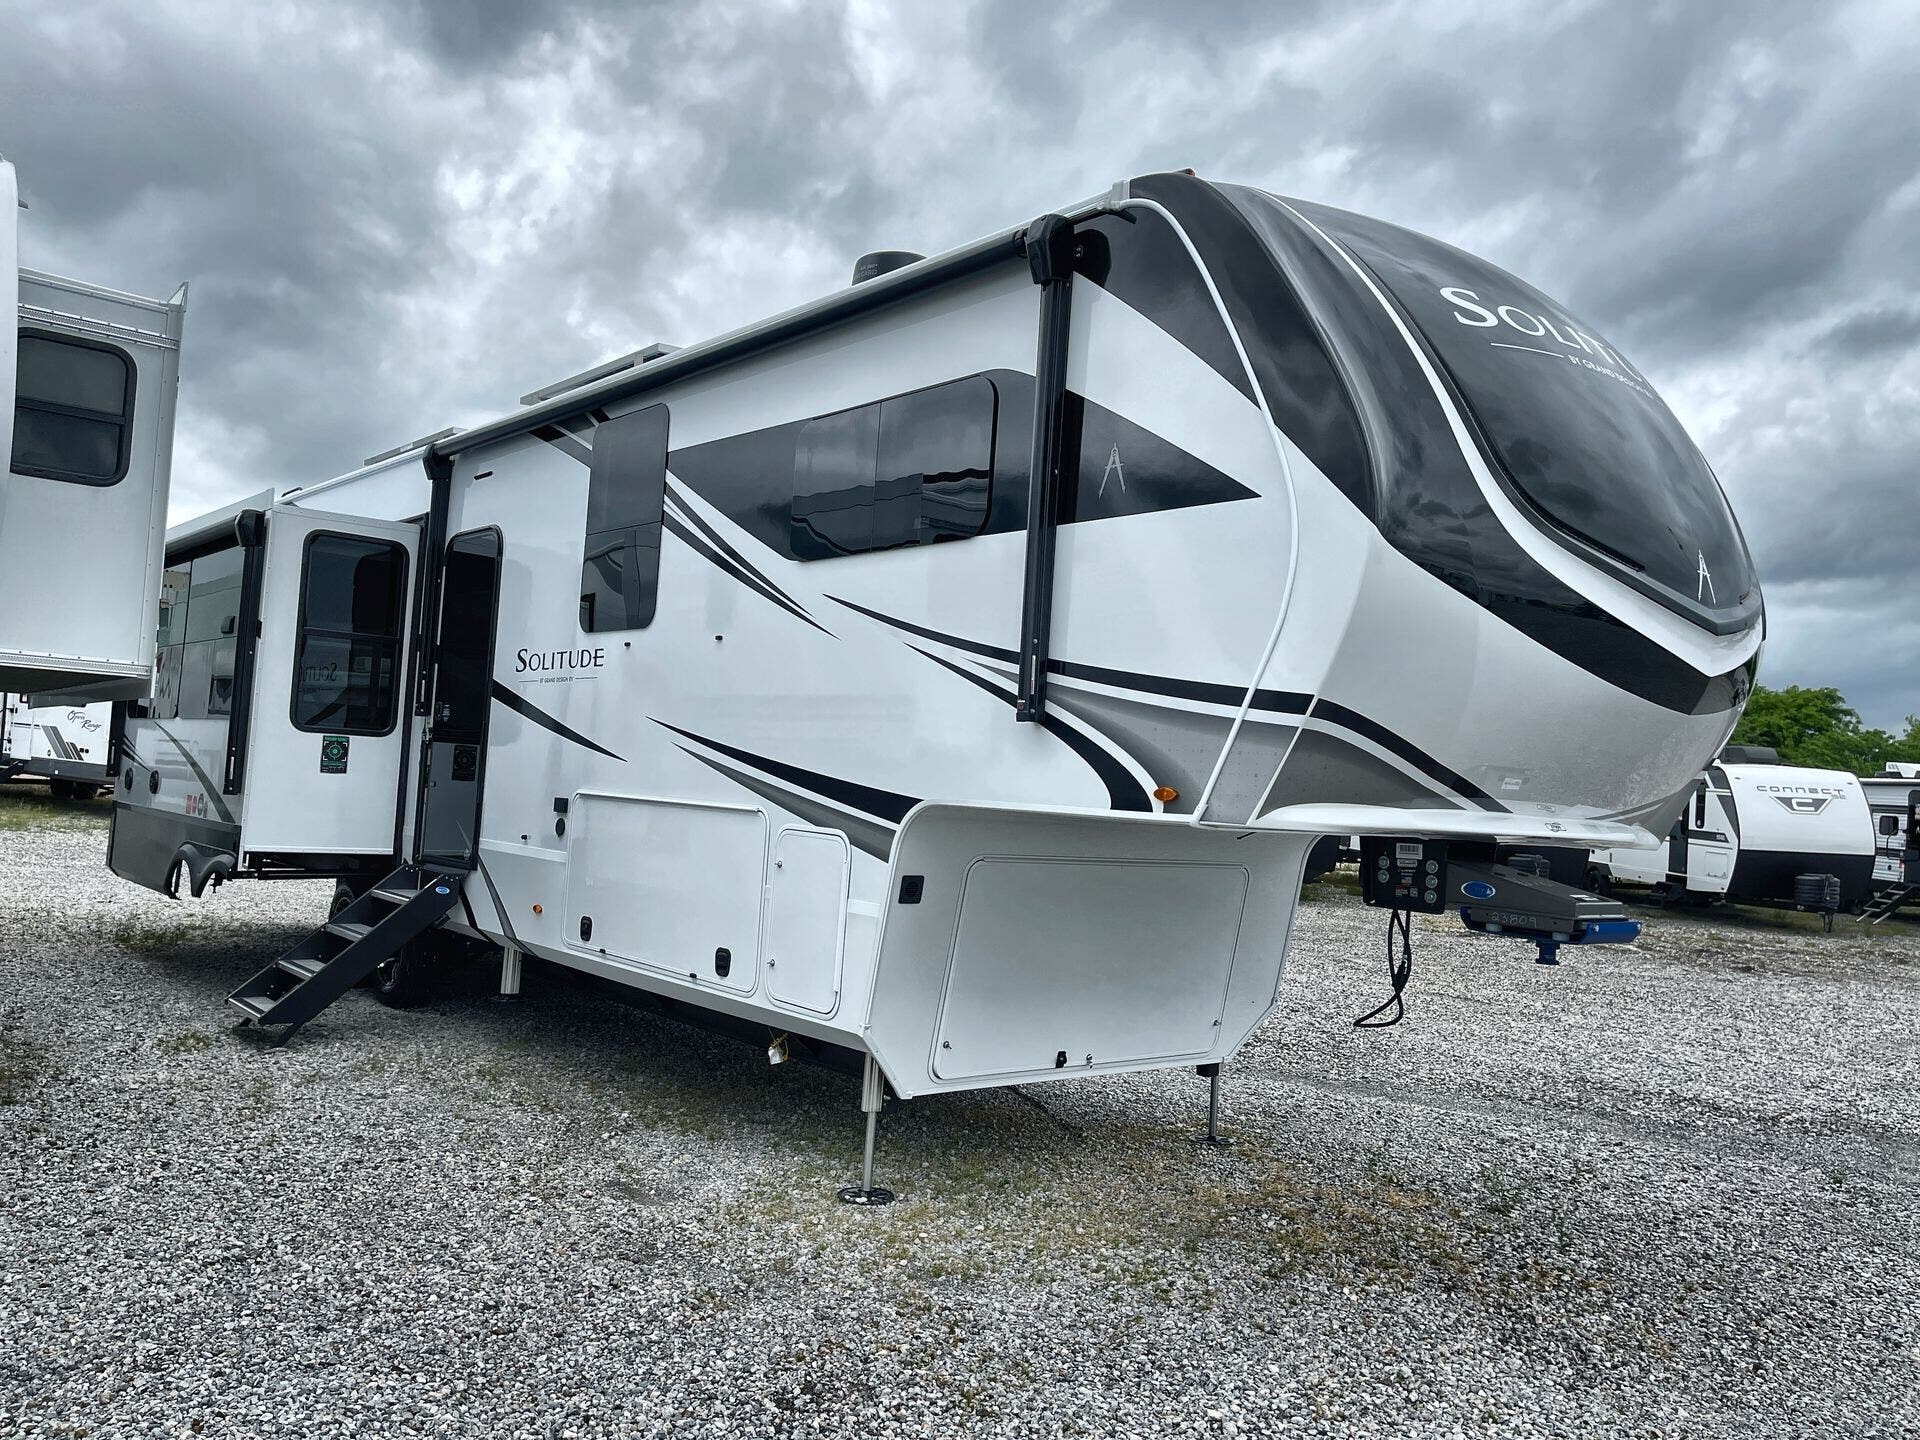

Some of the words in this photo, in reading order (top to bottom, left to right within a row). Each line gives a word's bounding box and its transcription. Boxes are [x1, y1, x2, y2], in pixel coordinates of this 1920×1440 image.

[1439, 287, 1645, 383] SOLITU
[515, 648, 605, 673] SOLITUDE
[67, 710, 87, 723] Open
[80, 719, 102, 732] Range
[1756, 785, 1844, 796] CONNECT
[1491, 911, 1537, 929] 23809
